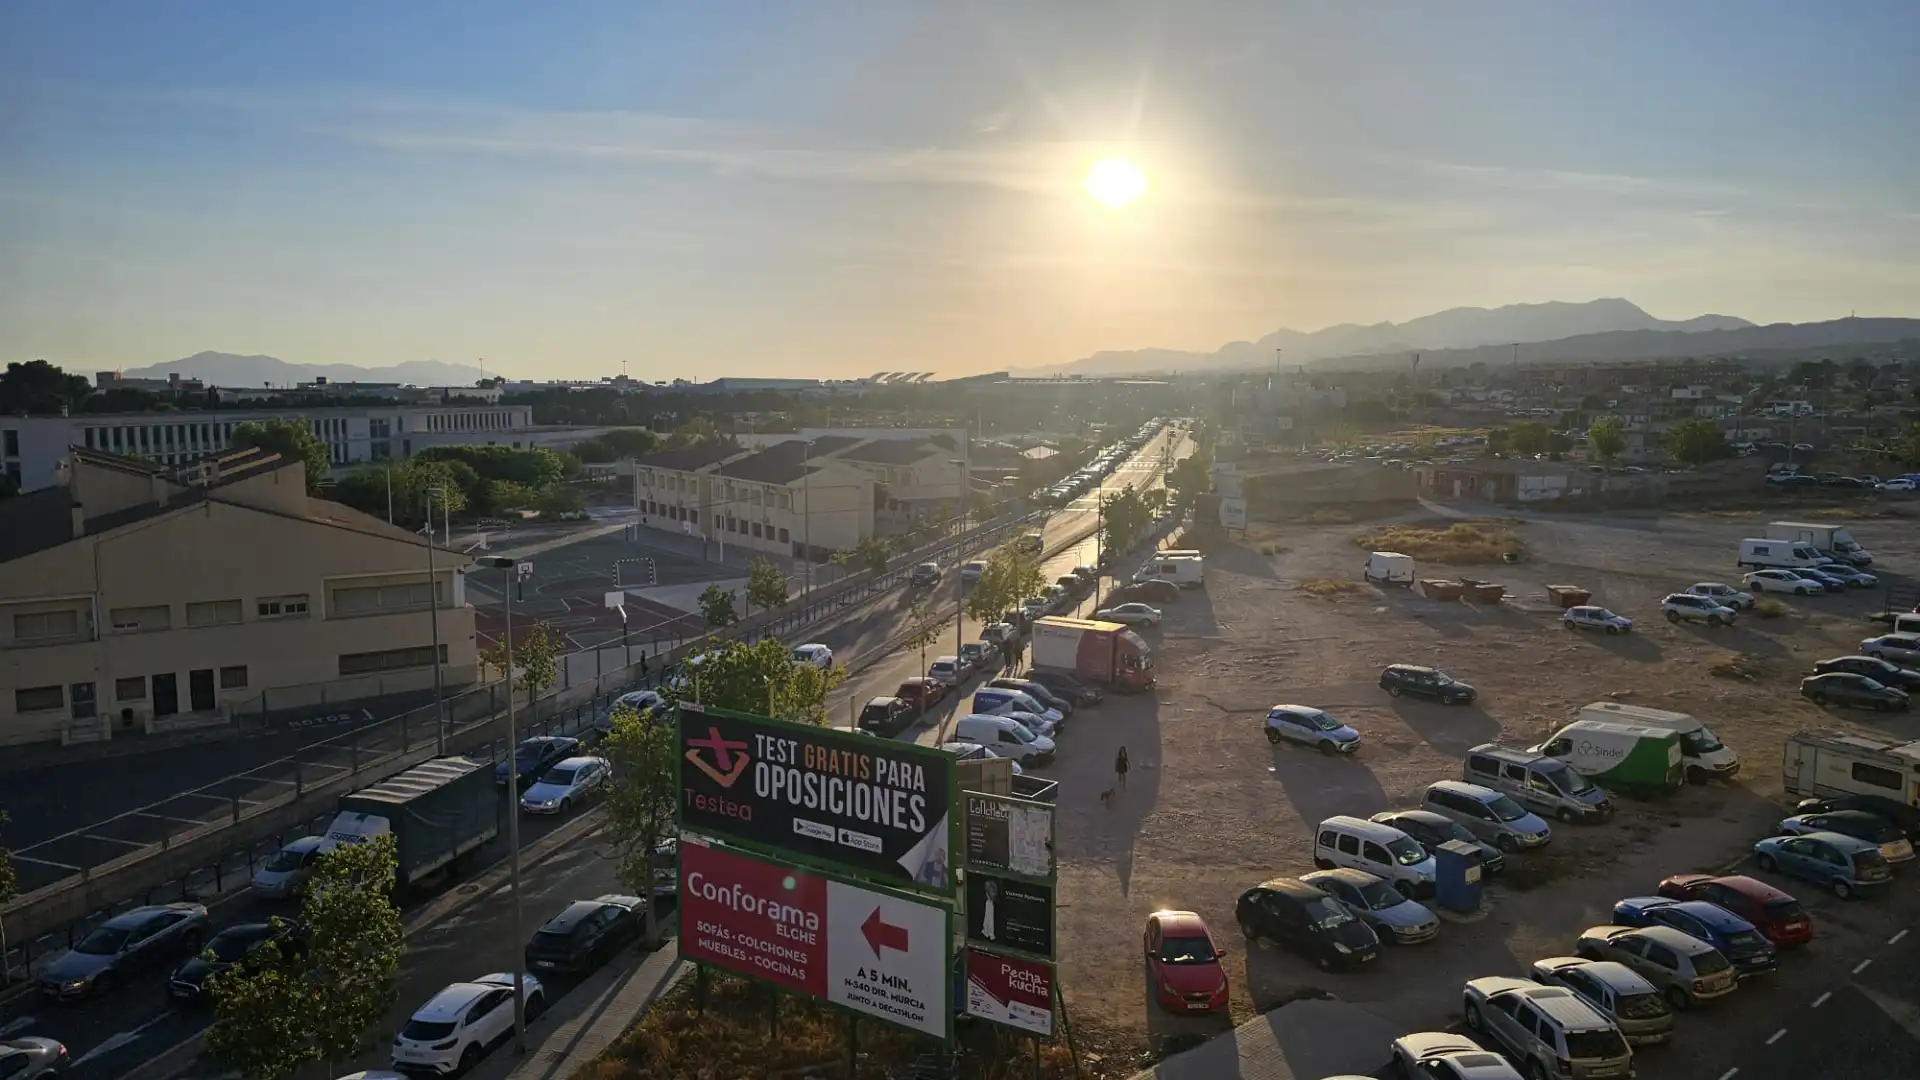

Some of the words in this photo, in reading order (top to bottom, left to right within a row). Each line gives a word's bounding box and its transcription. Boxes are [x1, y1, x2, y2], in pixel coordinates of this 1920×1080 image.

[755, 734, 797, 765] TEST
[804, 743, 870, 780] GRATIS
[876, 757, 925, 792] PARA
[1595, 746, 1624, 758] Sindel
[684, 788, 752, 821] Testea
[755, 761, 925, 833] OPOSICIONES
[687, 872, 819, 931] Conforama
[697, 920, 730, 940] SOFÁS
[738, 933, 807, 964] COLCHONES
[776, 923, 816, 945] ELCHE
[698, 937, 746, 961] MUEBLES
[754, 955, 806, 980] COCINAS
[1001, 963, 1048, 985] Pecha-
[844, 978, 870, 993] N-340
[871, 986, 889, 999] DIR.
[890, 993, 925, 1010] MURCIA
[857, 966, 867, 979] A
[870, 969, 878, 982] 5
[881, 972, 912, 993] MIN.
[1008, 976, 1049, 997] kucha
[847, 992, 871, 1005] JUNTO
[878, 1001, 924, 1022] DECATHLON
